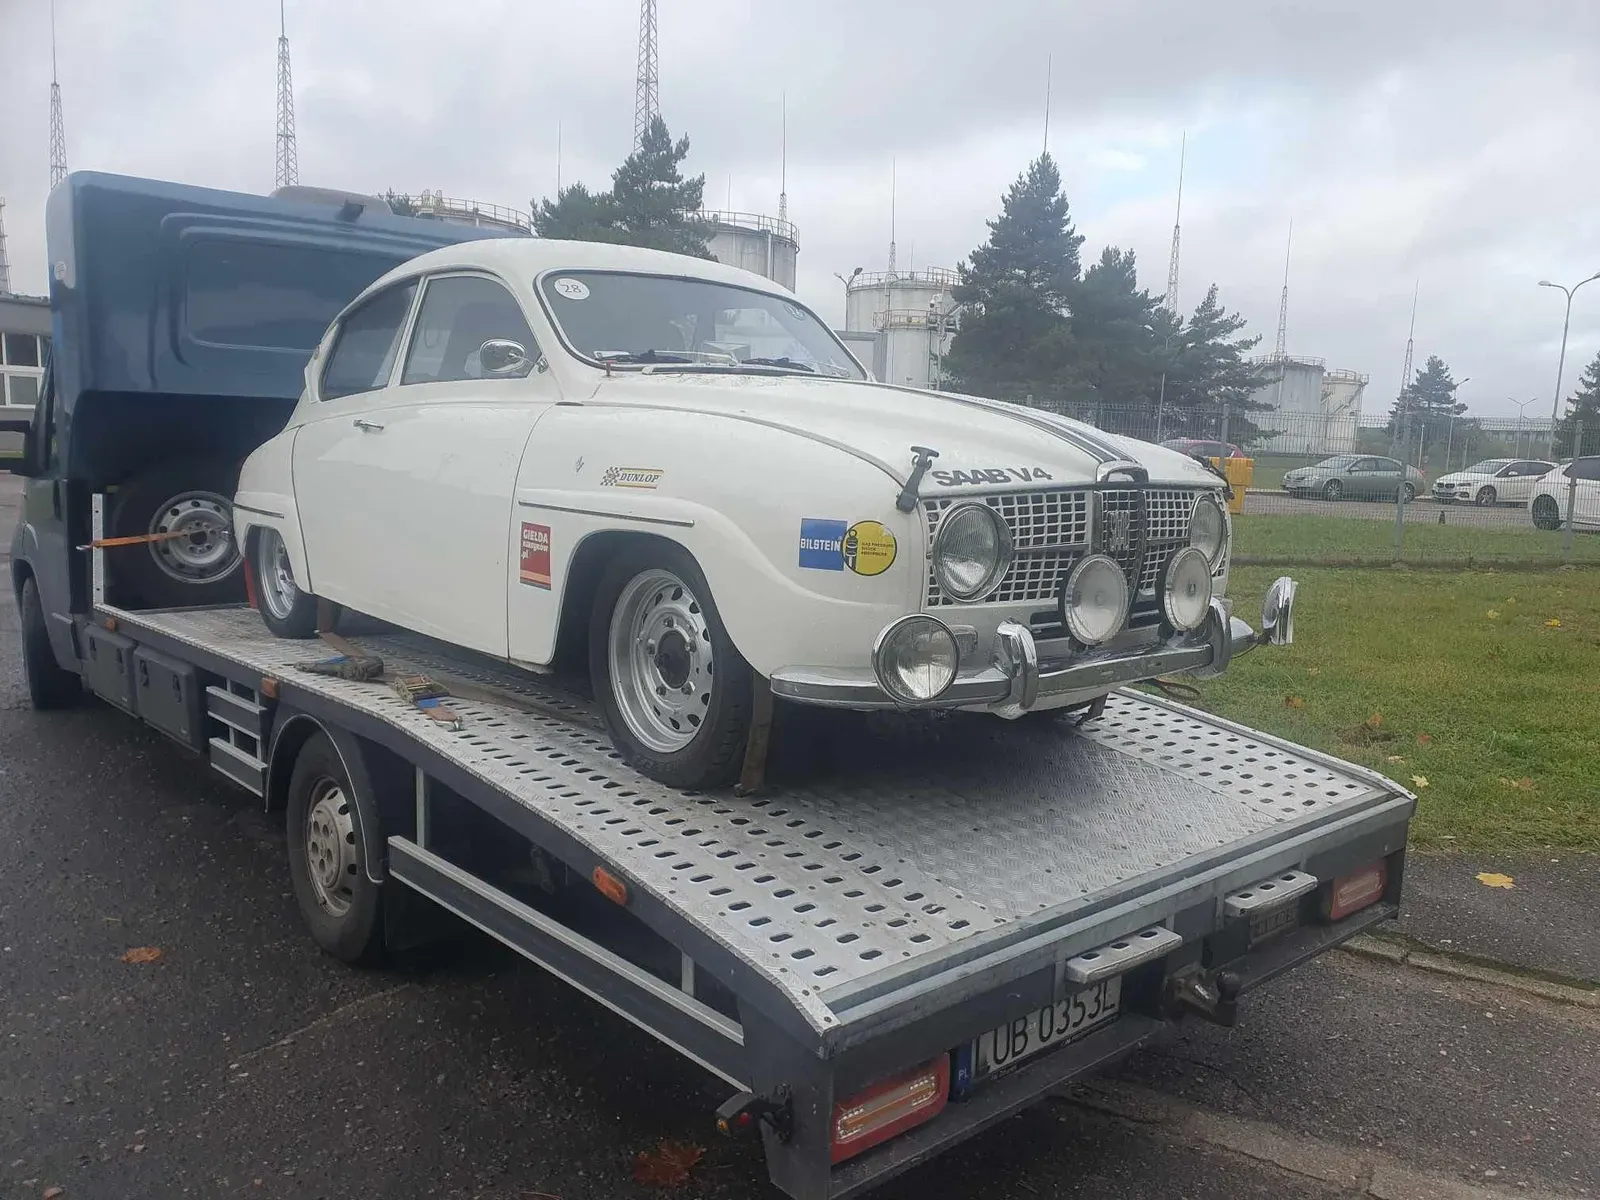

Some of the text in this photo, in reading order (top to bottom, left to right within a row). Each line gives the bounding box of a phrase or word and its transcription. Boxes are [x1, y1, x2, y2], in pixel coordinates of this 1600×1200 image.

[562, 284, 582, 293] 28
[619, 472, 660, 483] DUNLOP
[931, 467, 1054, 487] SAAB V4
[800, 538, 841, 552] BILSTEIN
[975, 1015, 1029, 1073] LUB
[1039, 981, 1116, 1043] 0353L
[958, 1068, 970, 1081] PL
